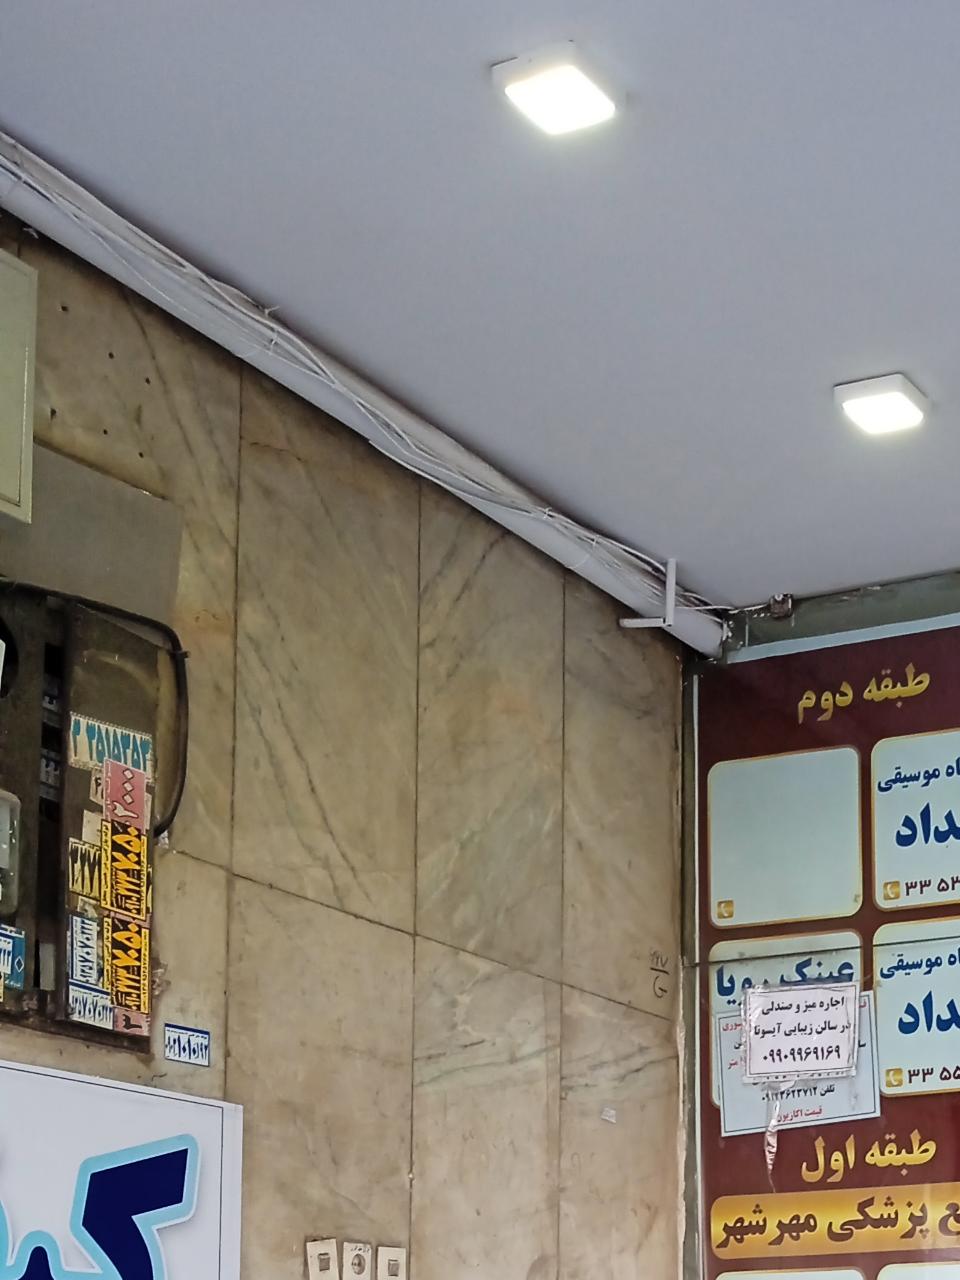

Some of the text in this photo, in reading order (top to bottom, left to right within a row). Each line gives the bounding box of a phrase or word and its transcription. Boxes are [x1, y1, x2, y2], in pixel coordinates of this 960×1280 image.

[798, 663, 930, 723] طبقه دوم
[878, 767, 940, 792] موسیقی
[880, 954, 942, 979] موسیقی
[762, 1001, 792, 1015] صندلی
[795, 1004, 800, 1013] و
[803, 1002, 816, 1013] میز
[819, 996, 844, 1011] اجاره
[784, 1023, 813, 1036] زیبایی
[815, 1020, 837, 1034] سالن
[763, 1045, 840, 1063] ۰۹۹۰۹۹۶۹۱۶۹
[820, 1084, 834, 1096] تلفن
[805, 1108, 822, 1116] قیمت
[802, 1129, 936, 1182] طبقه اول
[827, 1195, 928, 1240] پزشکی
